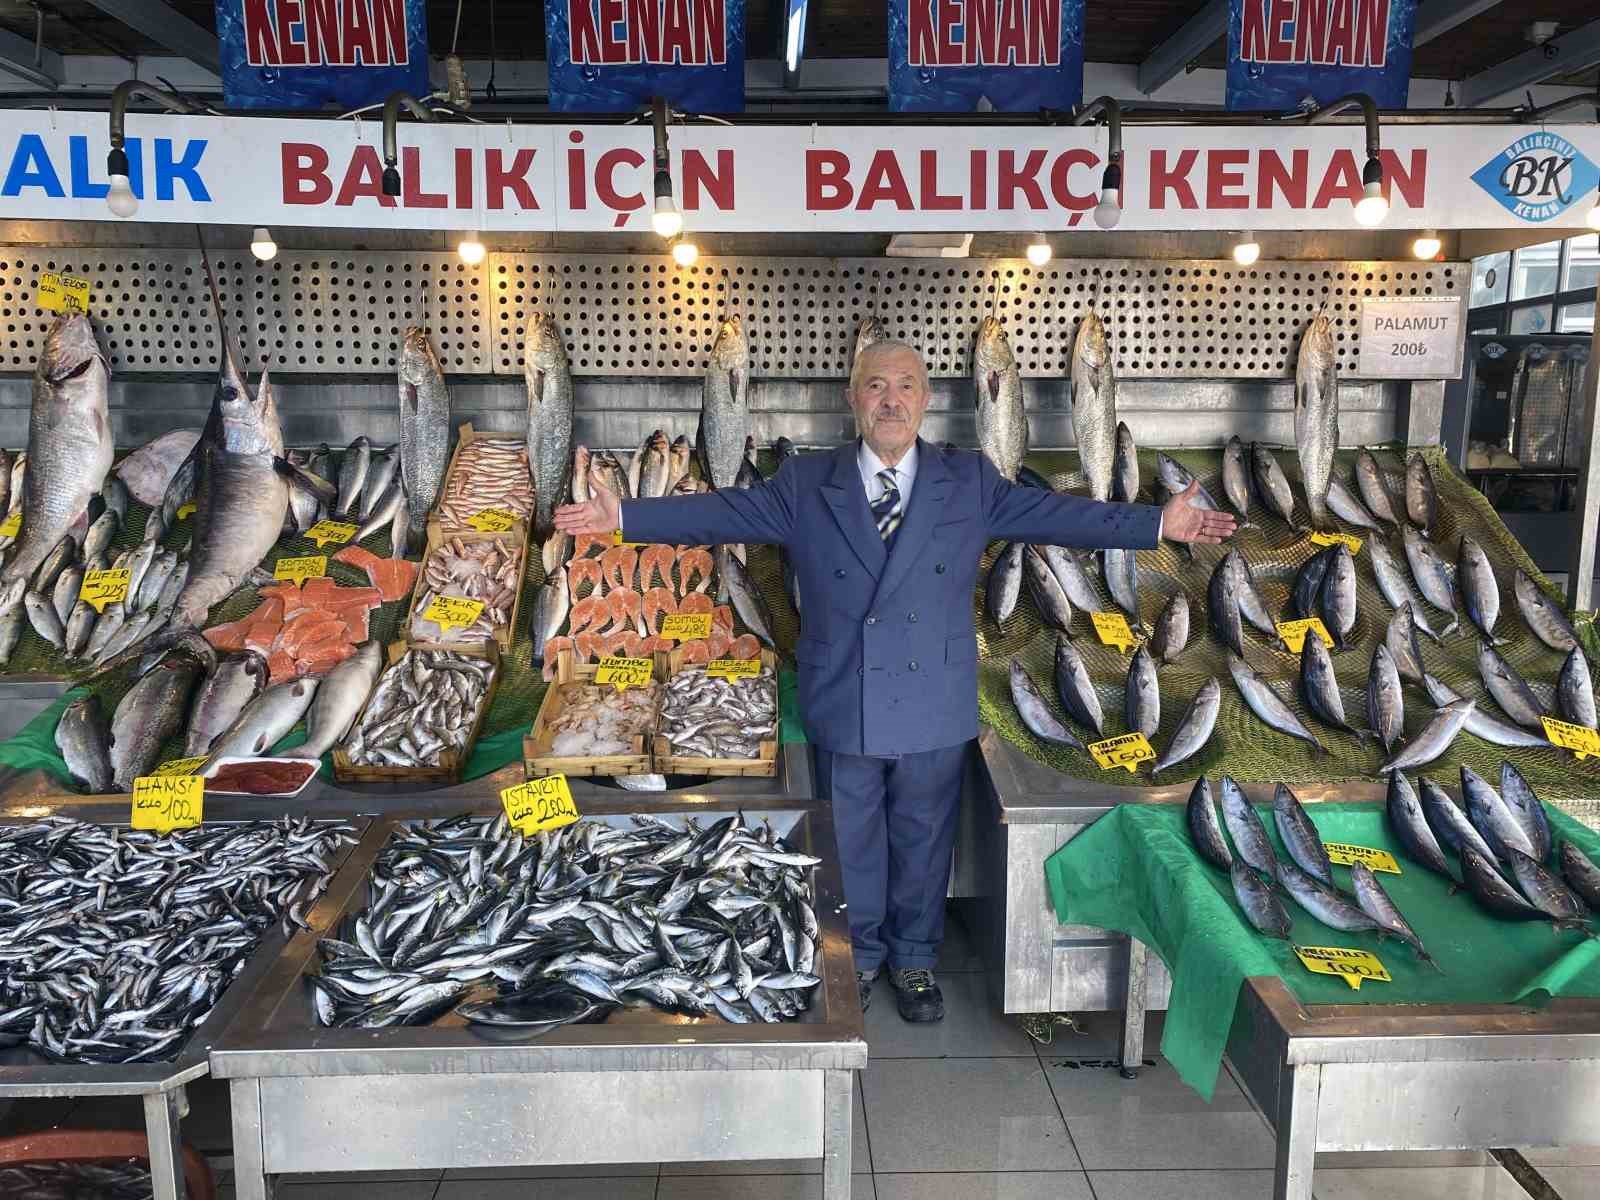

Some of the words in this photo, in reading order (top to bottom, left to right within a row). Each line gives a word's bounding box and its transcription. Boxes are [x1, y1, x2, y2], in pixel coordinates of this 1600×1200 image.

[242, 0, 409, 66] KENAN
[568, 0, 727, 65] KENAN
[908, 0, 1062, 66] KENAN
[1240, 0, 1391, 67] KENAN
[281, 142, 540, 210] BALIK
[569, 130, 735, 227] İÇN
[804, 149, 1125, 226] BALIKÇ
[1149, 149, 1427, 209] KENAN
[1499, 156, 1577, 205] BK
[1375, 317, 1448, 330] PALAMUT
[1391, 342, 1427, 356] 200₺
